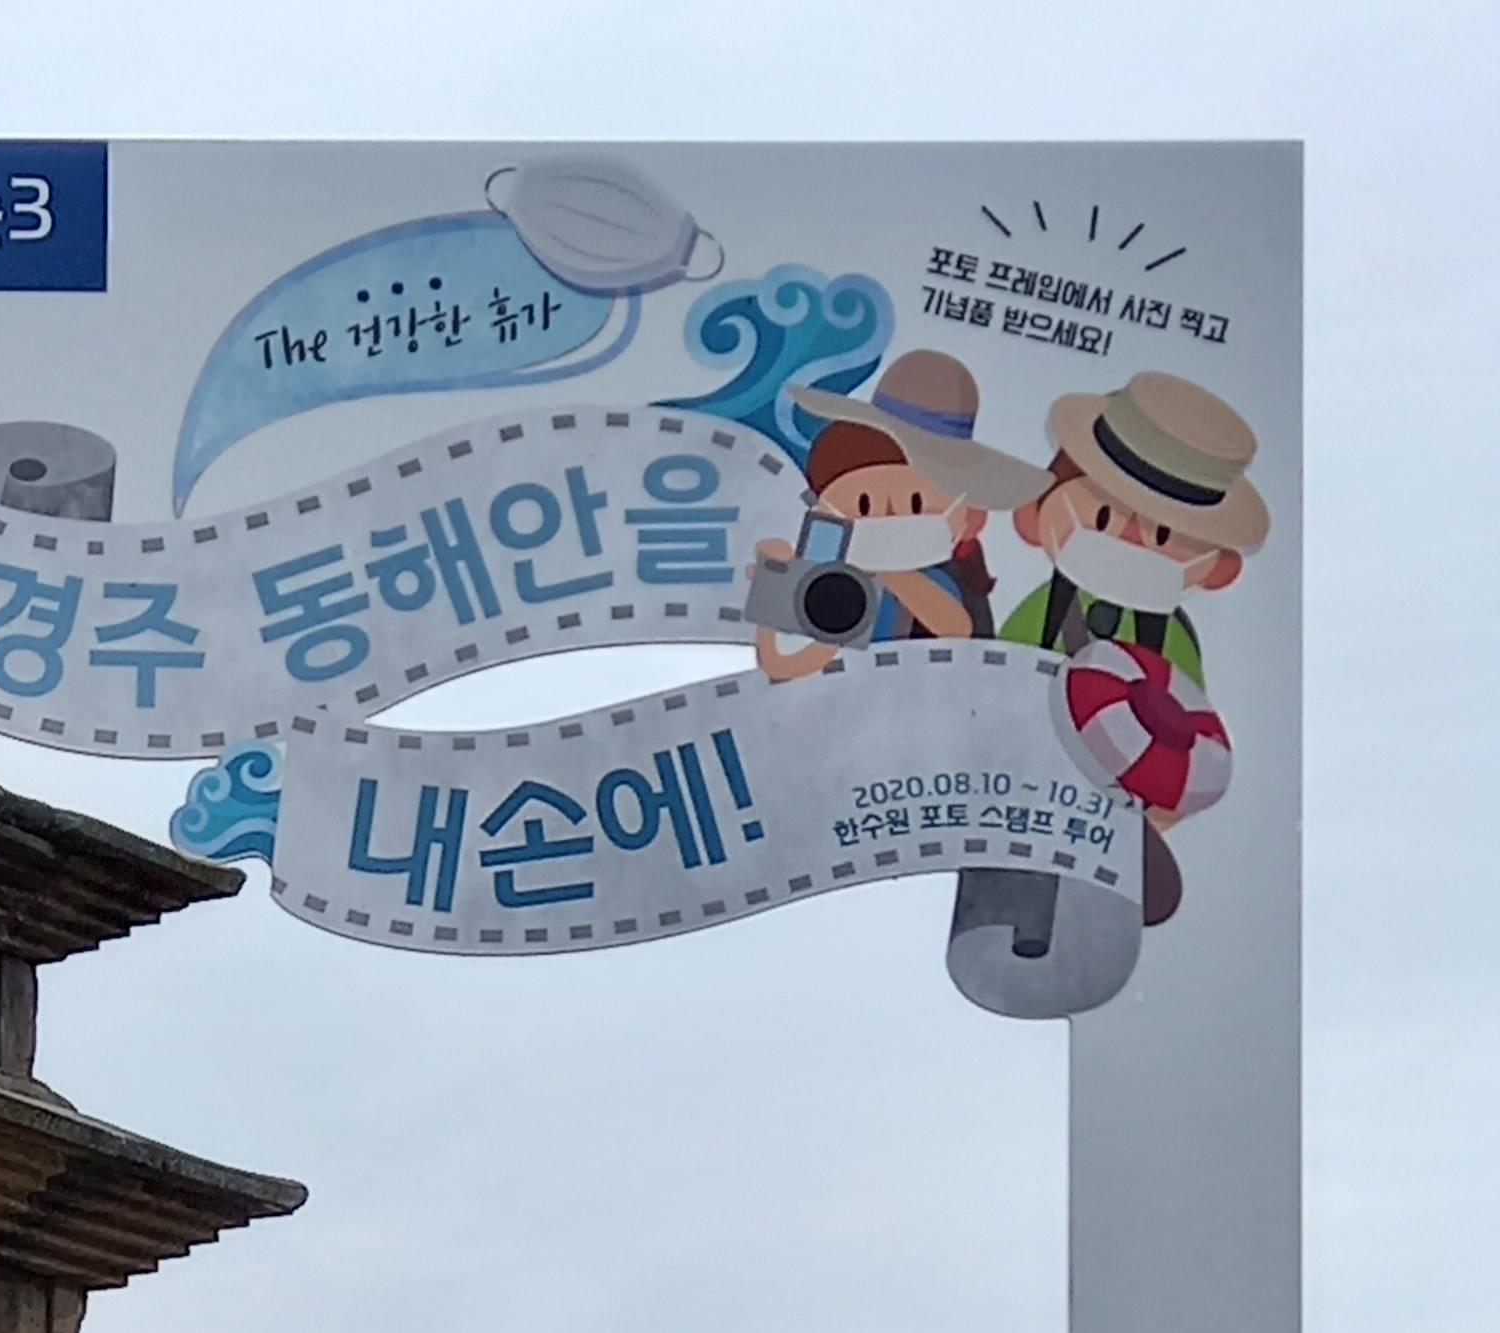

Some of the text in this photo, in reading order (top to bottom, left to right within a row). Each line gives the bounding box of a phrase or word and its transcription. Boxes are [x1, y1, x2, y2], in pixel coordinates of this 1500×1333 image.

[255, 286, 562, 369] The 건강한 휴가
[921, 286, 1114, 356] 기념품 받으세요!
[926, 247, 1230, 343] 포토 프레임에서 사진 찍고
[251, 454, 741, 683] 동해안을
[347, 729, 764, 912] 내손에!
[833, 804, 1115, 853] 한수원 포토 스탬프 투어
[852, 772, 1011, 808] 2020.08.10
[1049, 780, 1114, 819] 10.31
